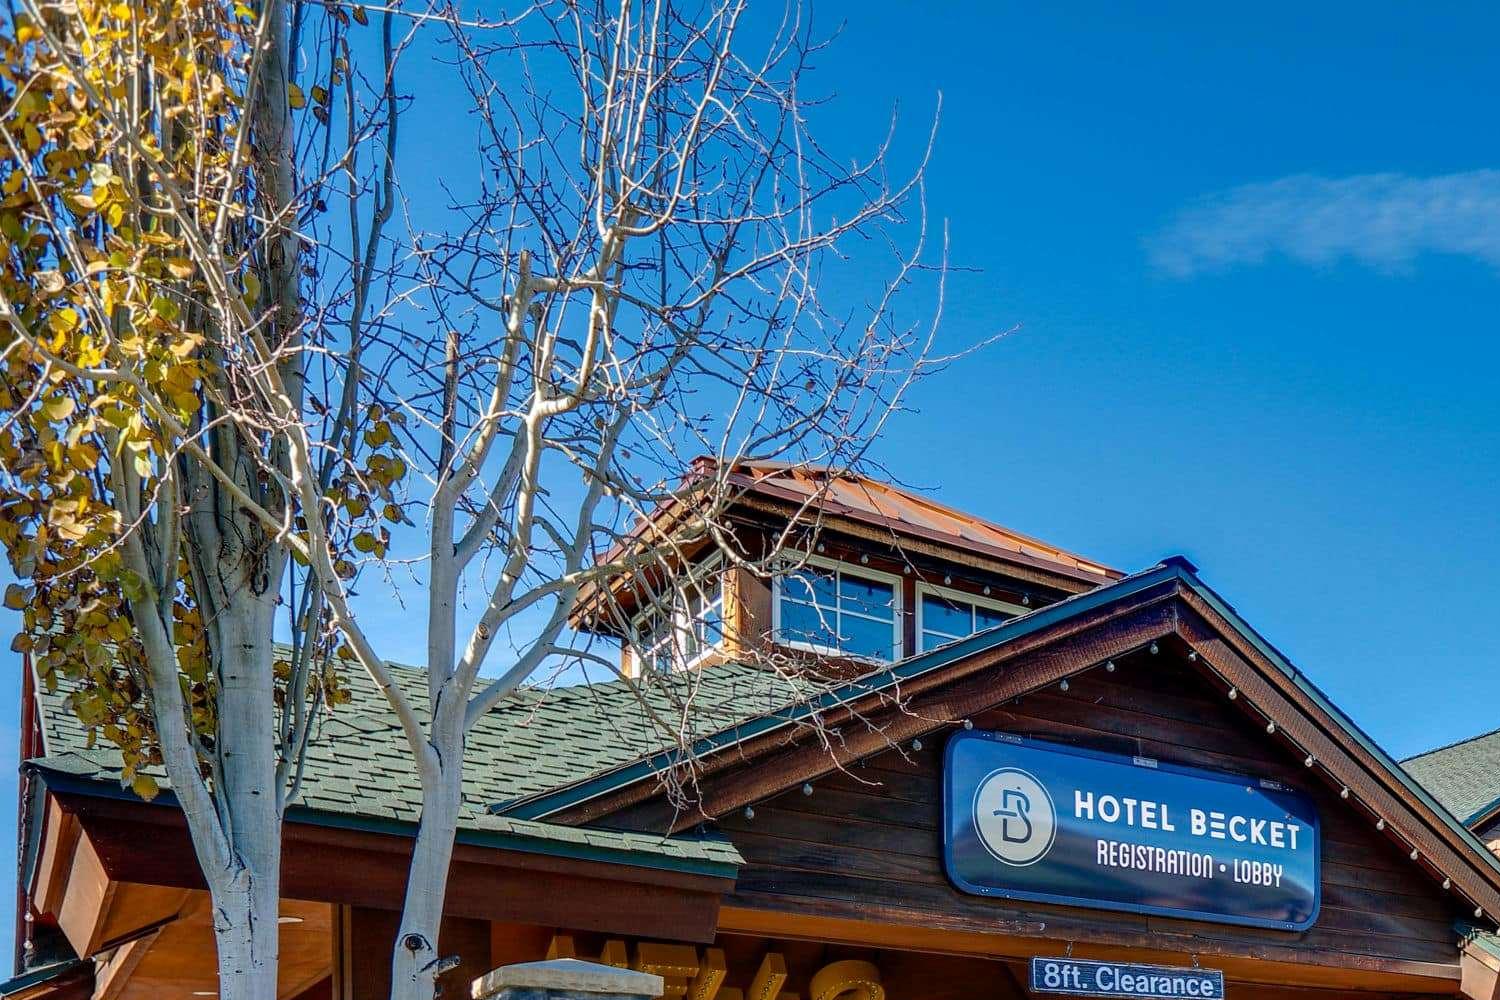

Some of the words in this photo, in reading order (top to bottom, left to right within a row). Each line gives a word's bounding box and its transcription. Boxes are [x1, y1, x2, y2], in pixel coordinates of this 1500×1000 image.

[1074, 789, 1175, 832] HOTEL
[1190, 808, 1300, 850] BECKET
[1096, 839, 1213, 879] REGISTRATION
[1233, 858, 1283, 888] LOBBY
[1043, 963, 1088, 989] 8ft.
[1095, 966, 1214, 997] Clearance
